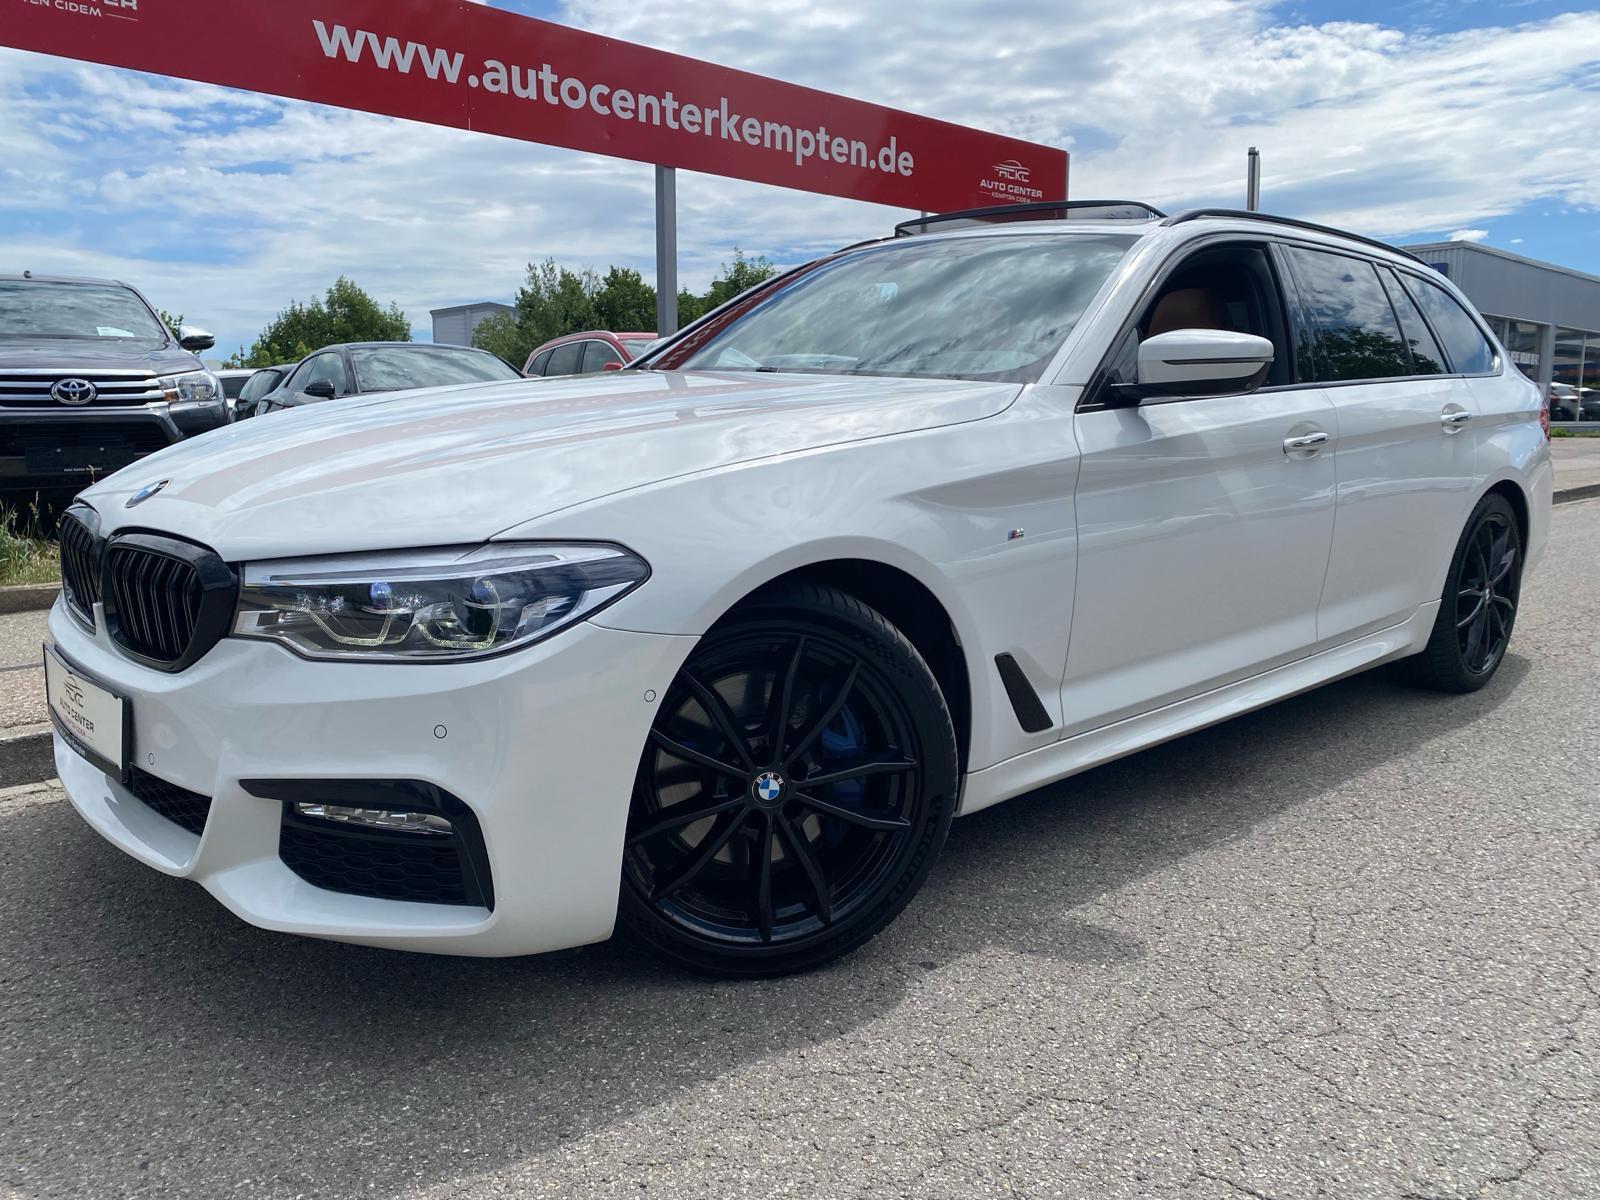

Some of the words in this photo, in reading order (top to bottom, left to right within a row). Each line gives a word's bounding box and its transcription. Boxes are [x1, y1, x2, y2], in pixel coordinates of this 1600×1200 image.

[54, 0, 102, 17] CIDEM
[312, 19, 914, 176] www.autocenterkempten.de
[980, 179, 1006, 191] AUTO
[1007, 184, 1043, 199] CENTER
[71, 708, 95, 733] CENTER
